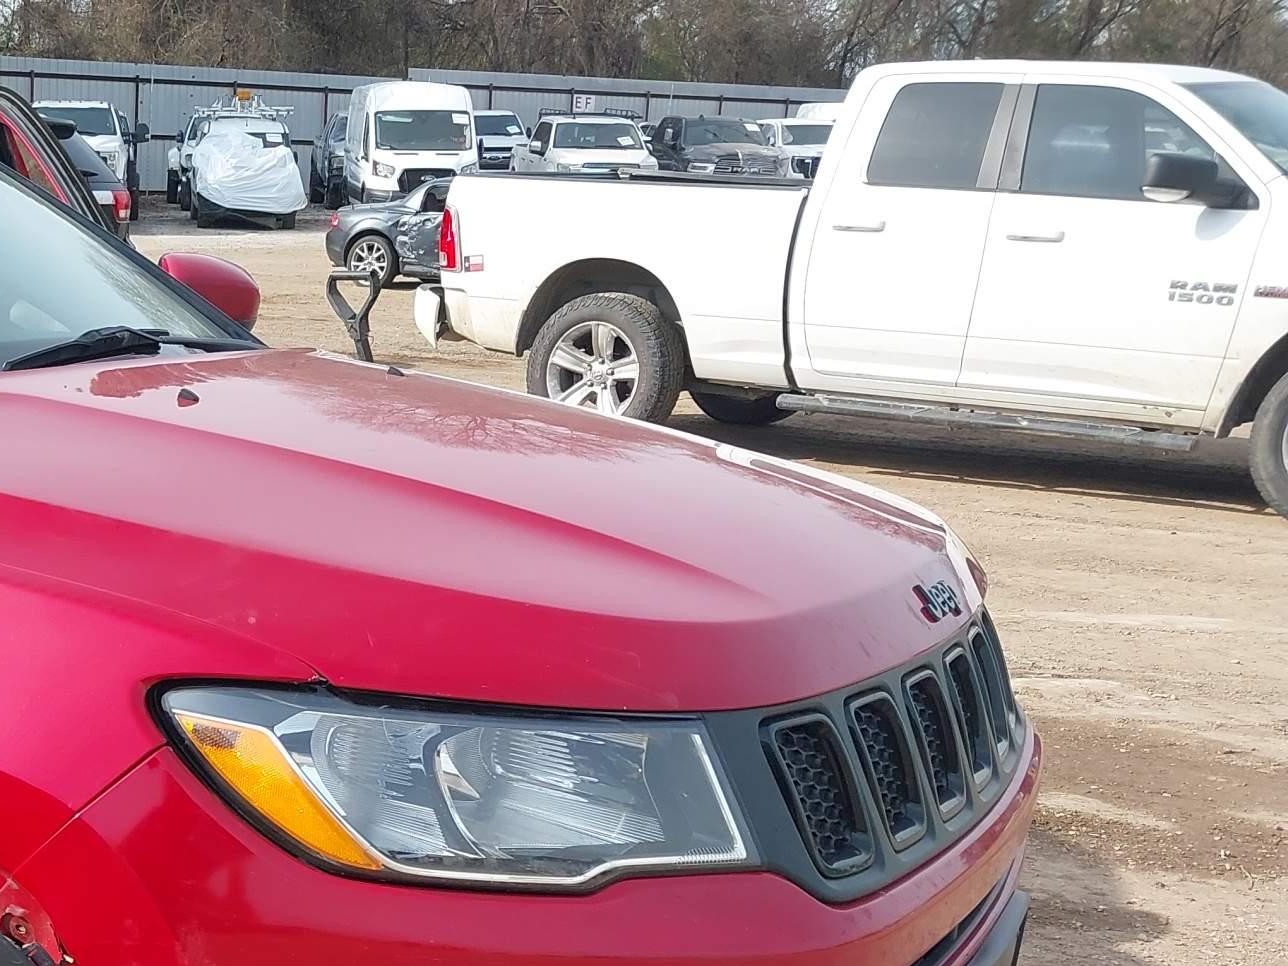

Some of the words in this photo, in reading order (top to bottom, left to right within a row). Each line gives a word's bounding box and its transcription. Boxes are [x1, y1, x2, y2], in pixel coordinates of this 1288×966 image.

[1169, 280, 1237, 293] RAM
[1167, 291, 1234, 306] 1500
[912, 580, 963, 623] Jeep
